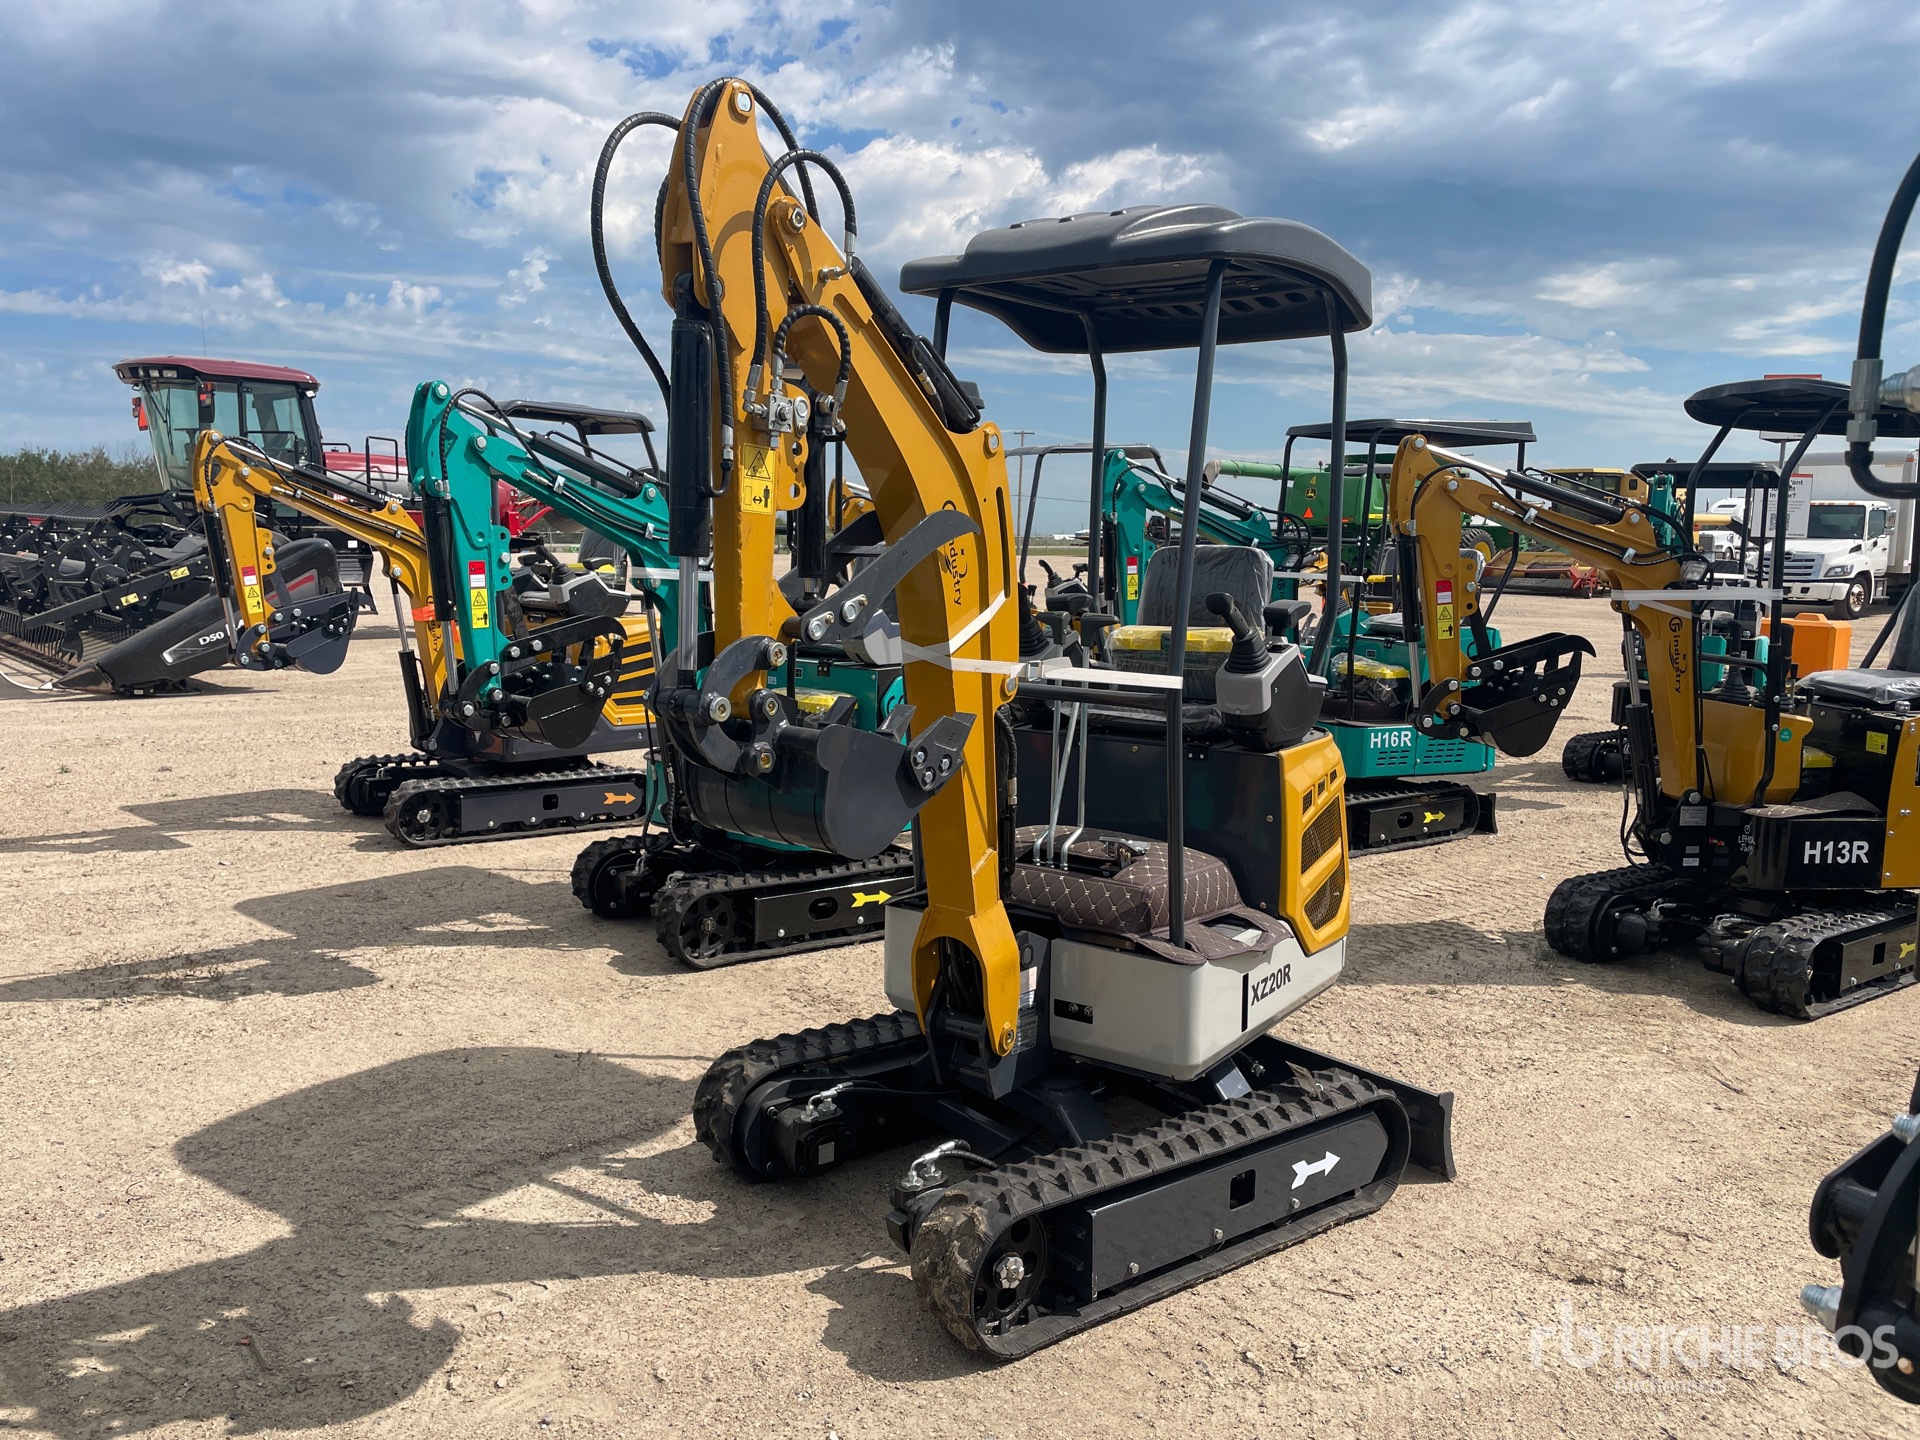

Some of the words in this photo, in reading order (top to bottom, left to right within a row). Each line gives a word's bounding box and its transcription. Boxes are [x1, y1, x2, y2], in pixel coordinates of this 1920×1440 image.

[199, 631, 225, 646] D50
[1370, 730, 1412, 749] H16R
[1803, 840, 1870, 865] H13R
[1250, 963, 1291, 1007] XZ20R
